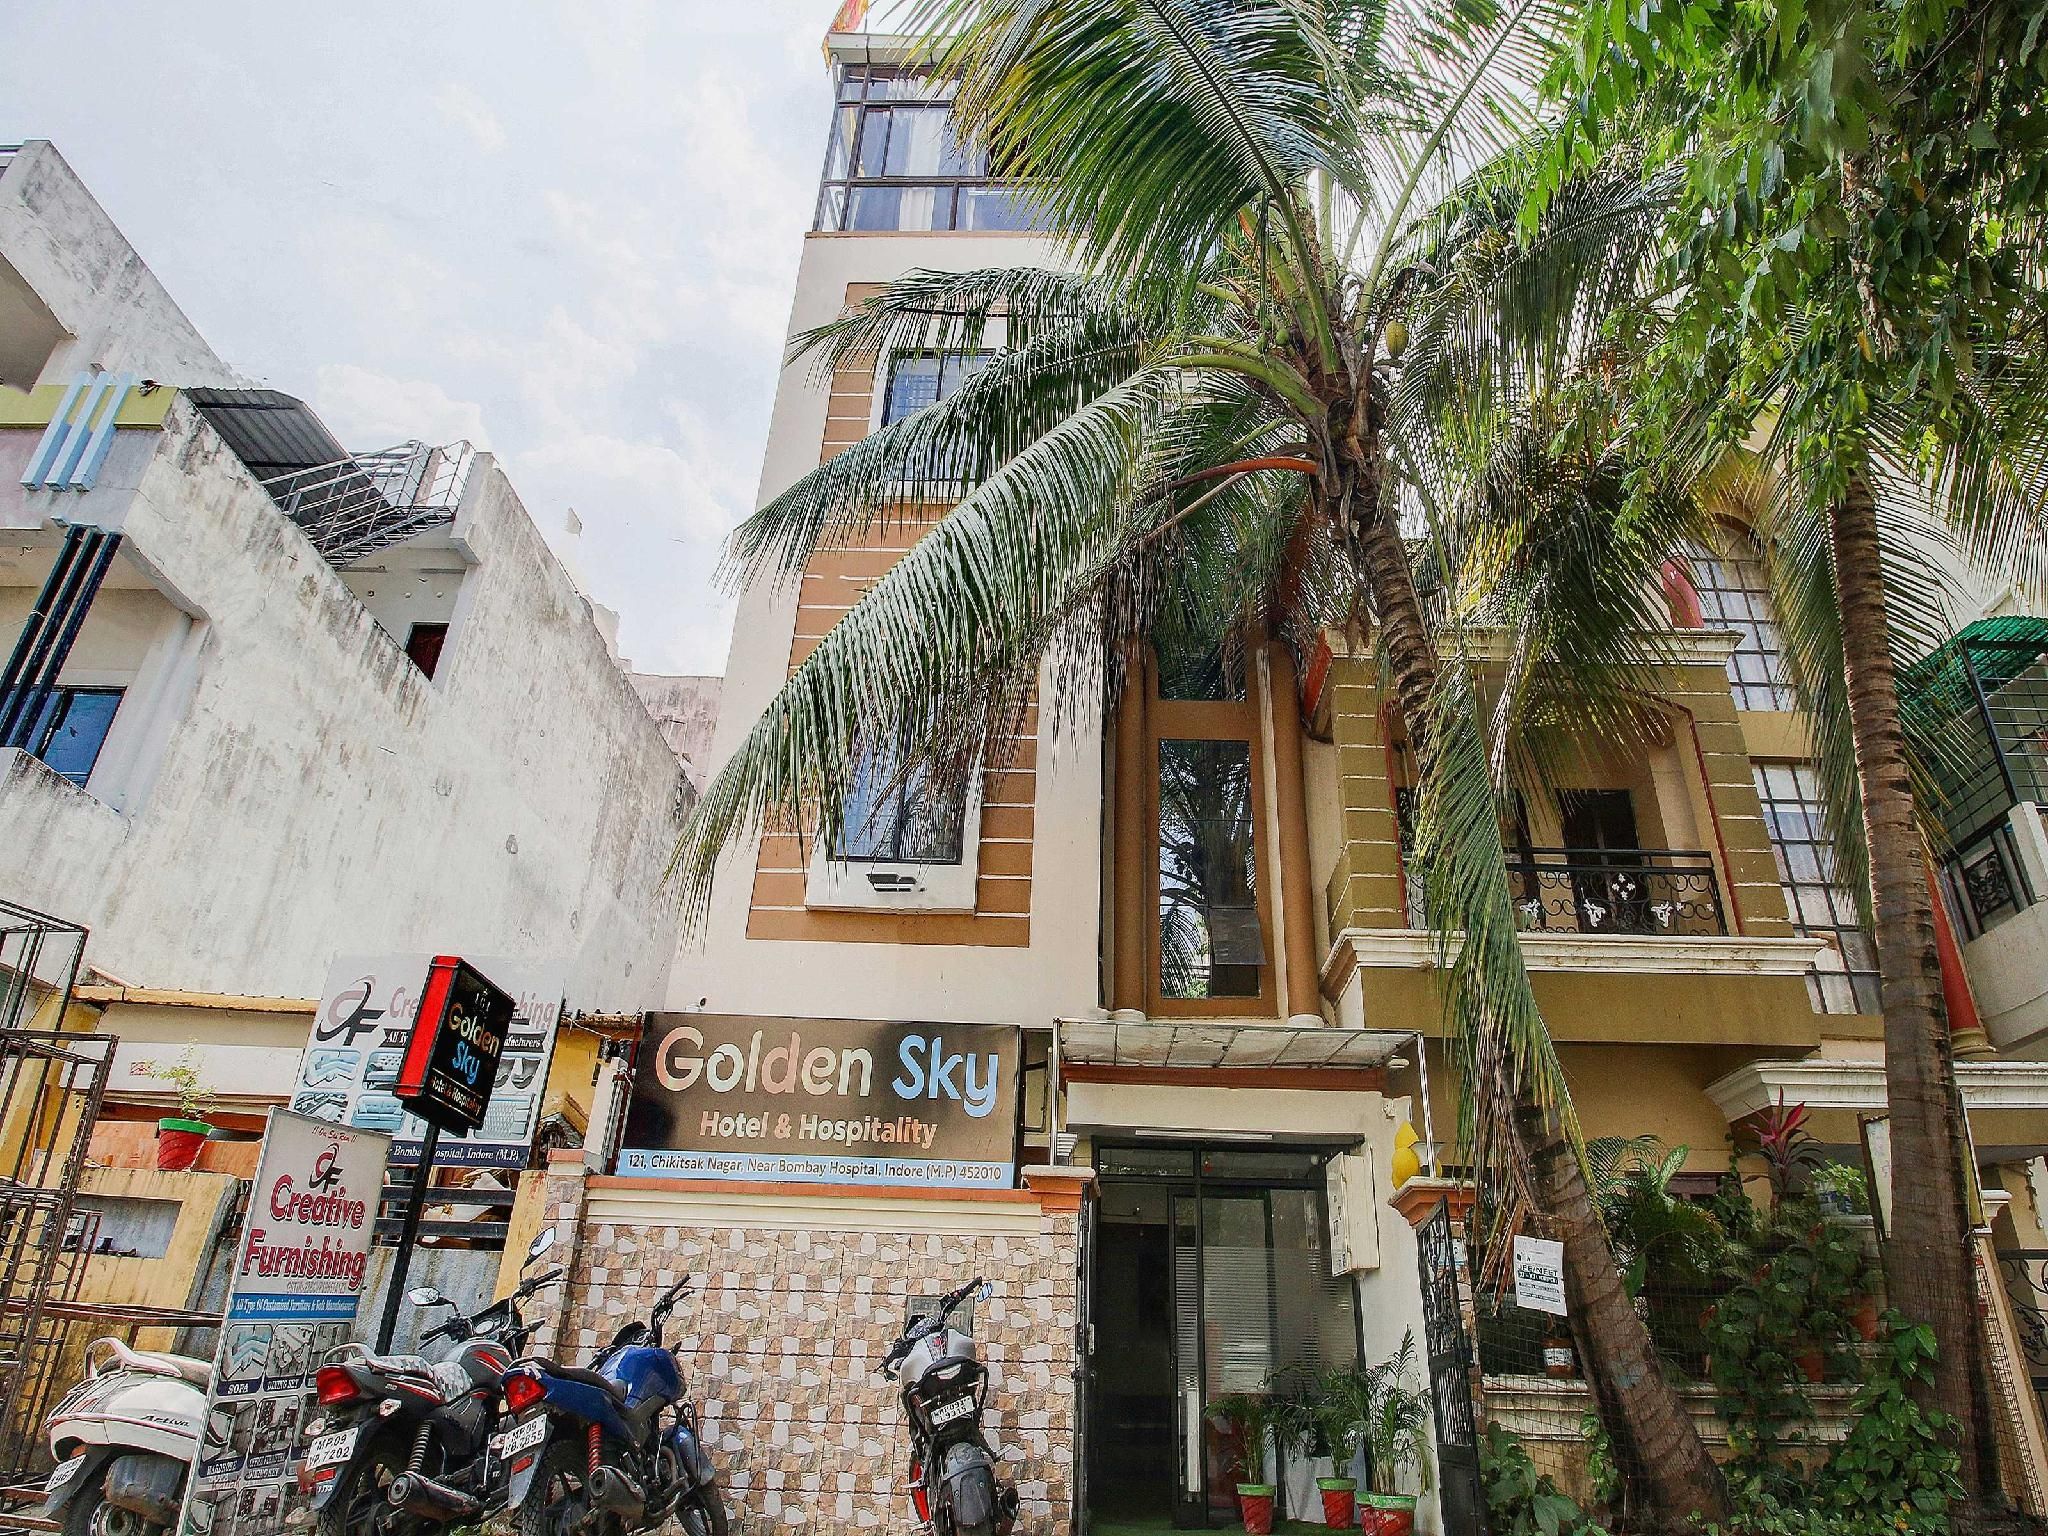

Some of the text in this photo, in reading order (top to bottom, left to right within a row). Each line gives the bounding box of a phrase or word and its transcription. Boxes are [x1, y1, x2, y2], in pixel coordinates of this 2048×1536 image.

[449, 1002, 500, 1058] Golden
[452, 1040, 480, 1085] Sky
[655, 1026, 999, 1118] Golden Sky
[700, 1111, 938, 1149] Hotel & Hospitality
[394, 1145, 422, 1158] Bomba
[434, 1146, 464, 1161] ospital,
[467, 1147, 494, 1160] Indore
[627, 1154, 1002, 1182] 121, Chikitsak Nagar, Near Bombay Hospital, Indore (M.P) 452010
[270, 1174, 366, 1229] Creative
[242, 1228, 366, 1291] Furnishing
[227, 1382, 249, 1395] SOFA
